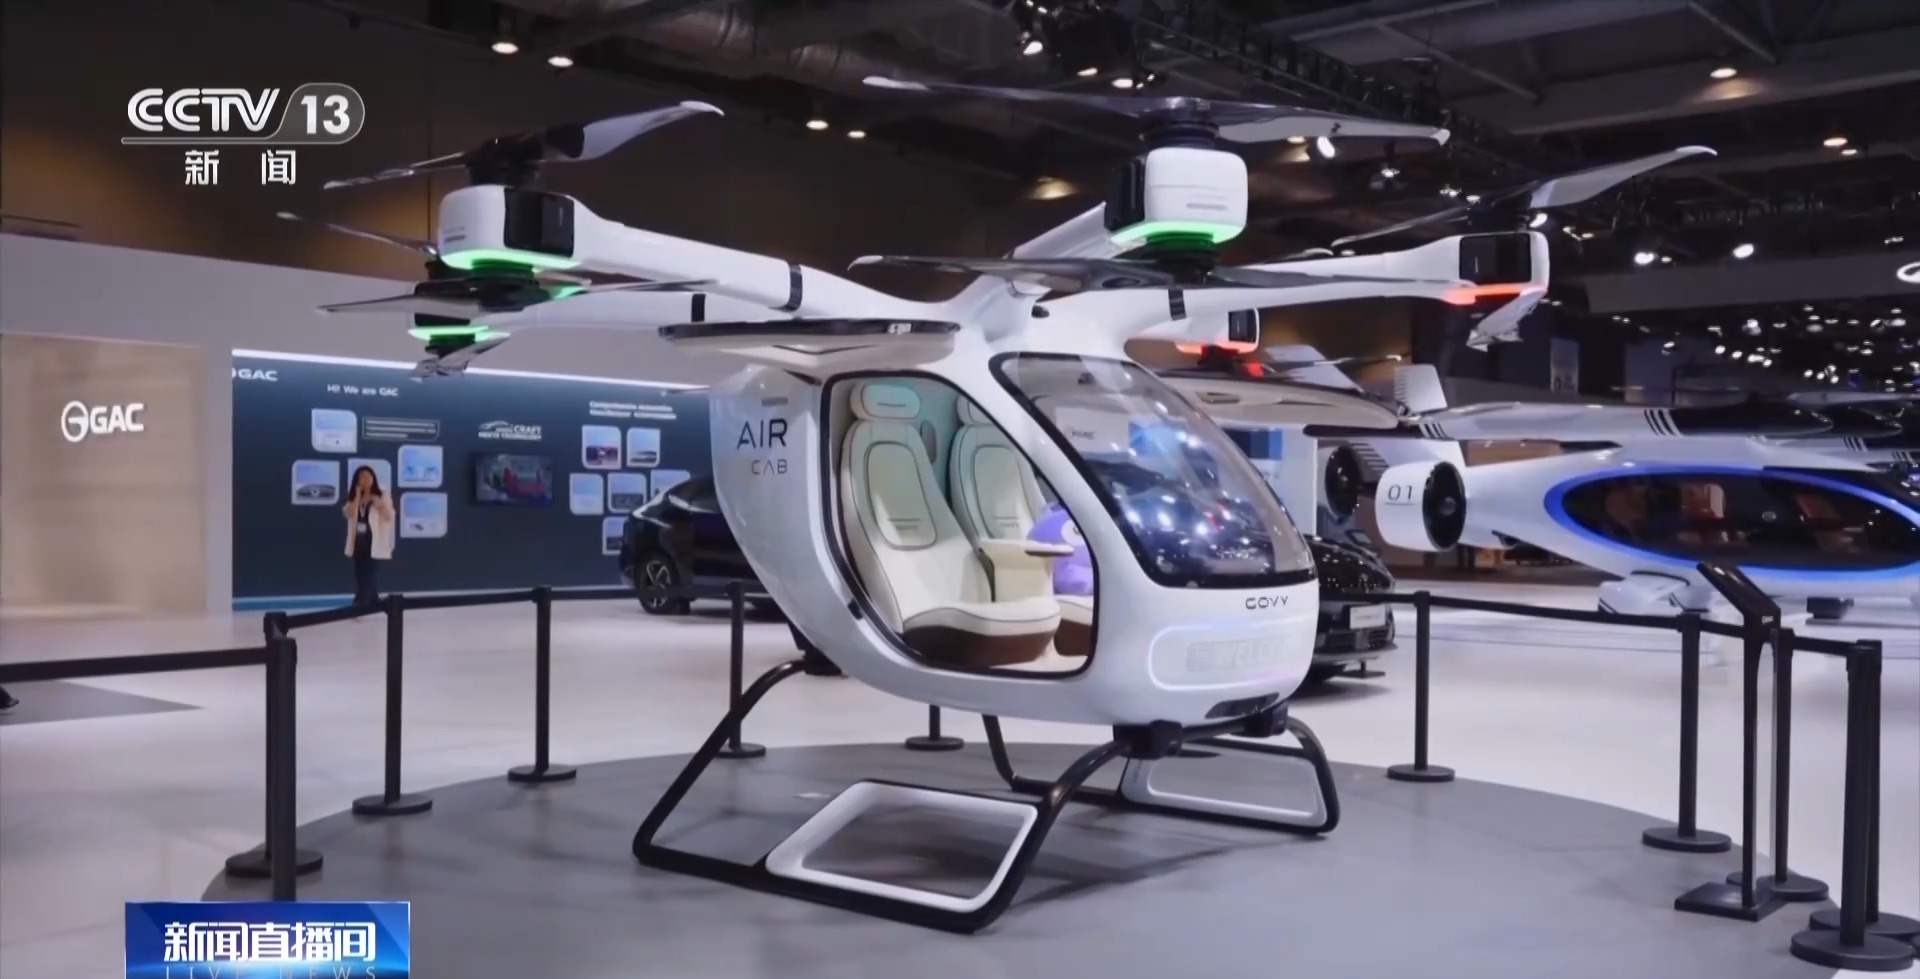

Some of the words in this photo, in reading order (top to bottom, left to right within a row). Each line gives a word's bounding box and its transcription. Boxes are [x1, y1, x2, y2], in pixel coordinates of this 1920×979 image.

[238, 369, 278, 382] GAC
[89, 402, 145, 434] GAC
[737, 418, 788, 450] AIR
[751, 459, 788, 475] CAB
[1388, 484, 1413, 500] 01
